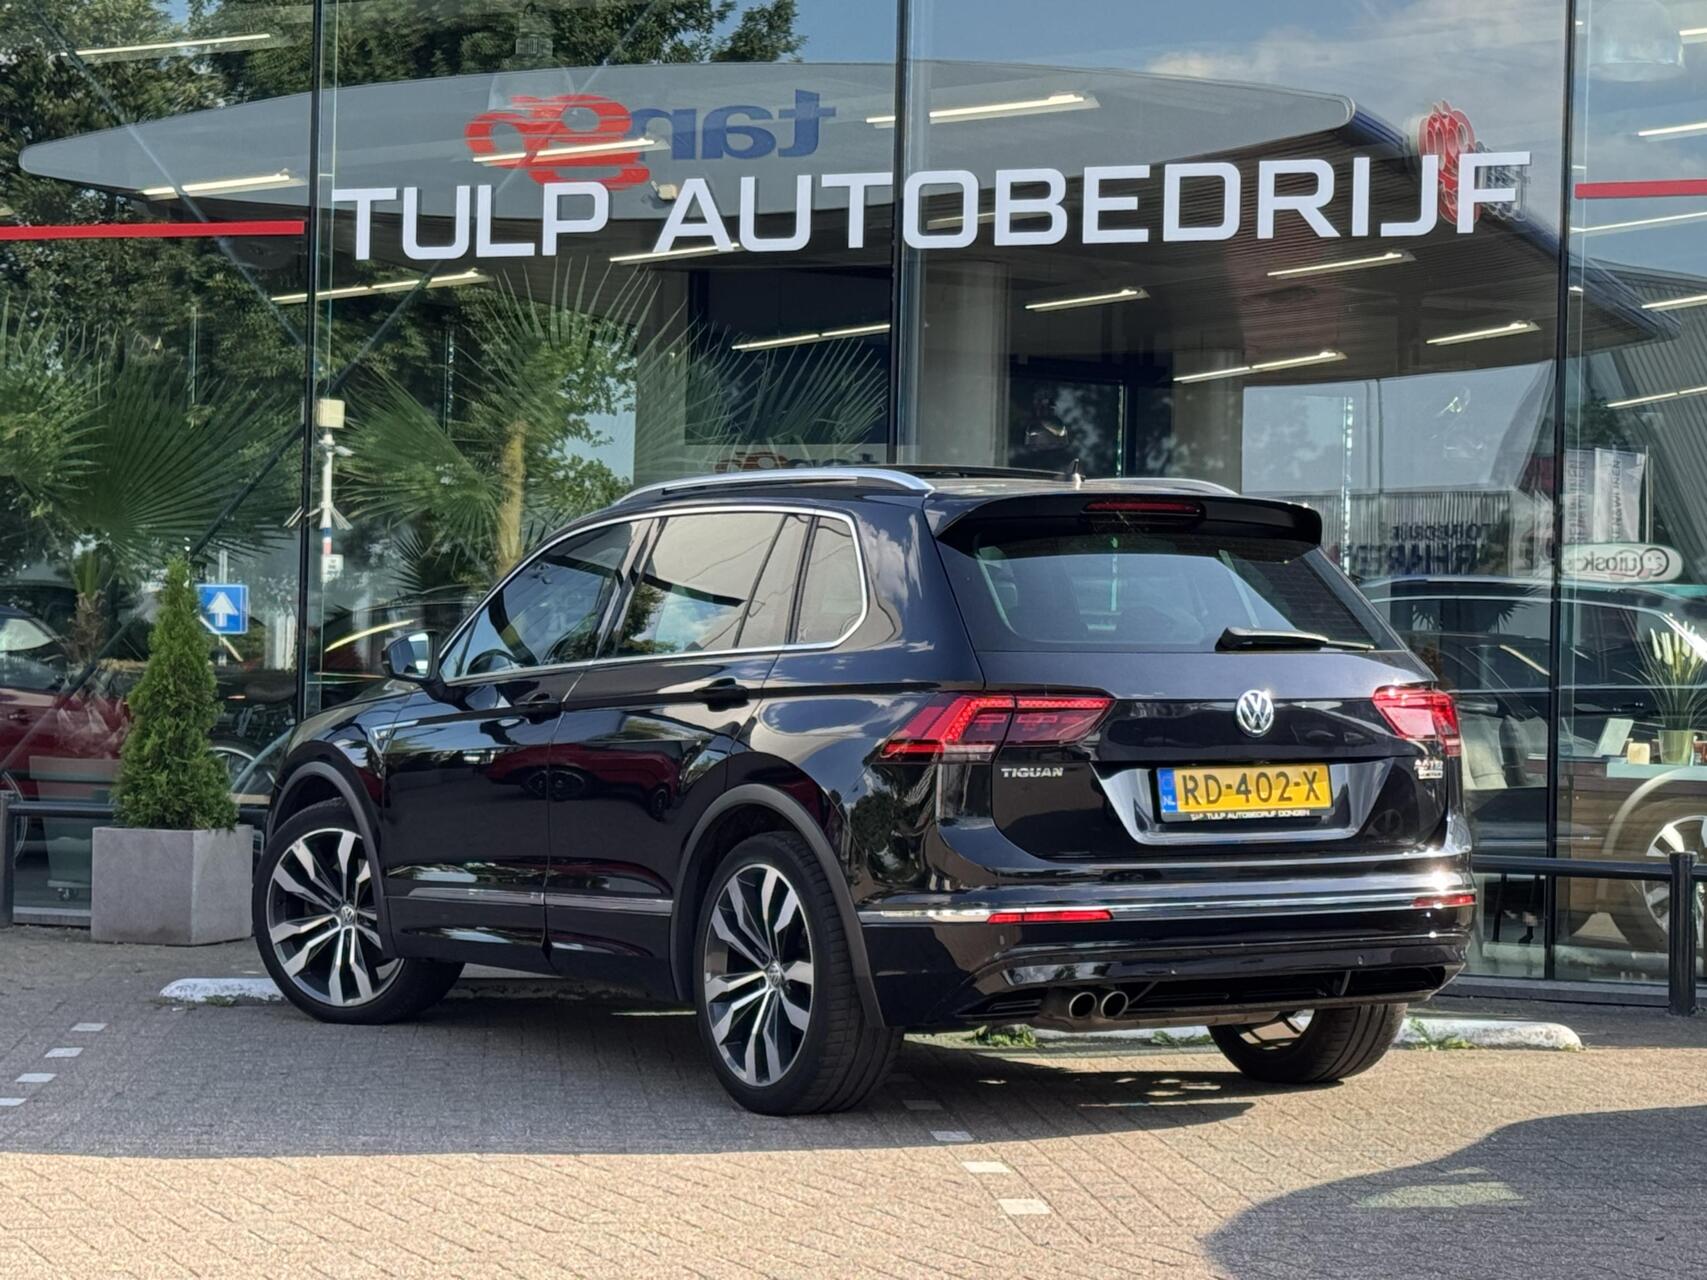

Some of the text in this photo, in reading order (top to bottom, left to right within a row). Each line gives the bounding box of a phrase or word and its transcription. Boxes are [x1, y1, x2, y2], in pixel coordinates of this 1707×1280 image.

[331, 151, 1531, 261] TULP AUTOBEDRIJF
[1000, 767, 1064, 778] TIGUAN
[1181, 770, 1321, 807] RD-402-X
[1206, 811, 1226, 820] TULP
